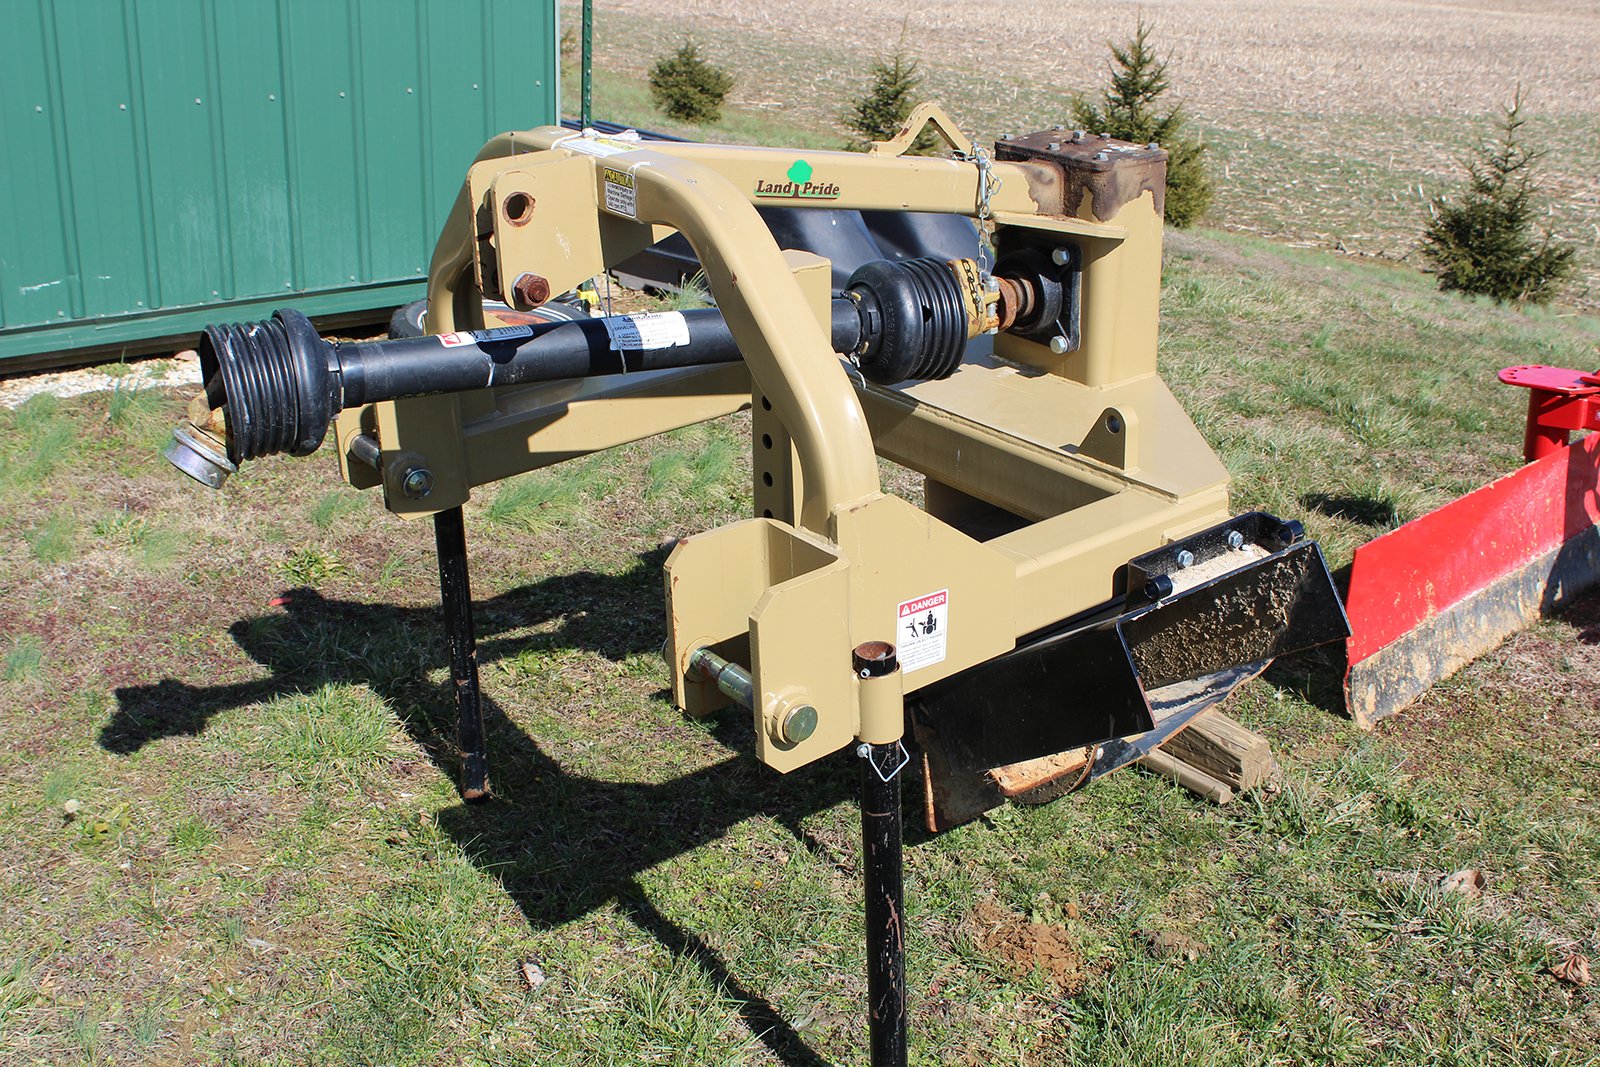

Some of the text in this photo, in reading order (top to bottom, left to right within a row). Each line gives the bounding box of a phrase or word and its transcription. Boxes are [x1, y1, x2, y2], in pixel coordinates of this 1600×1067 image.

[756, 180, 840, 195] Land Pride
[911, 594, 945, 612] DANGER
